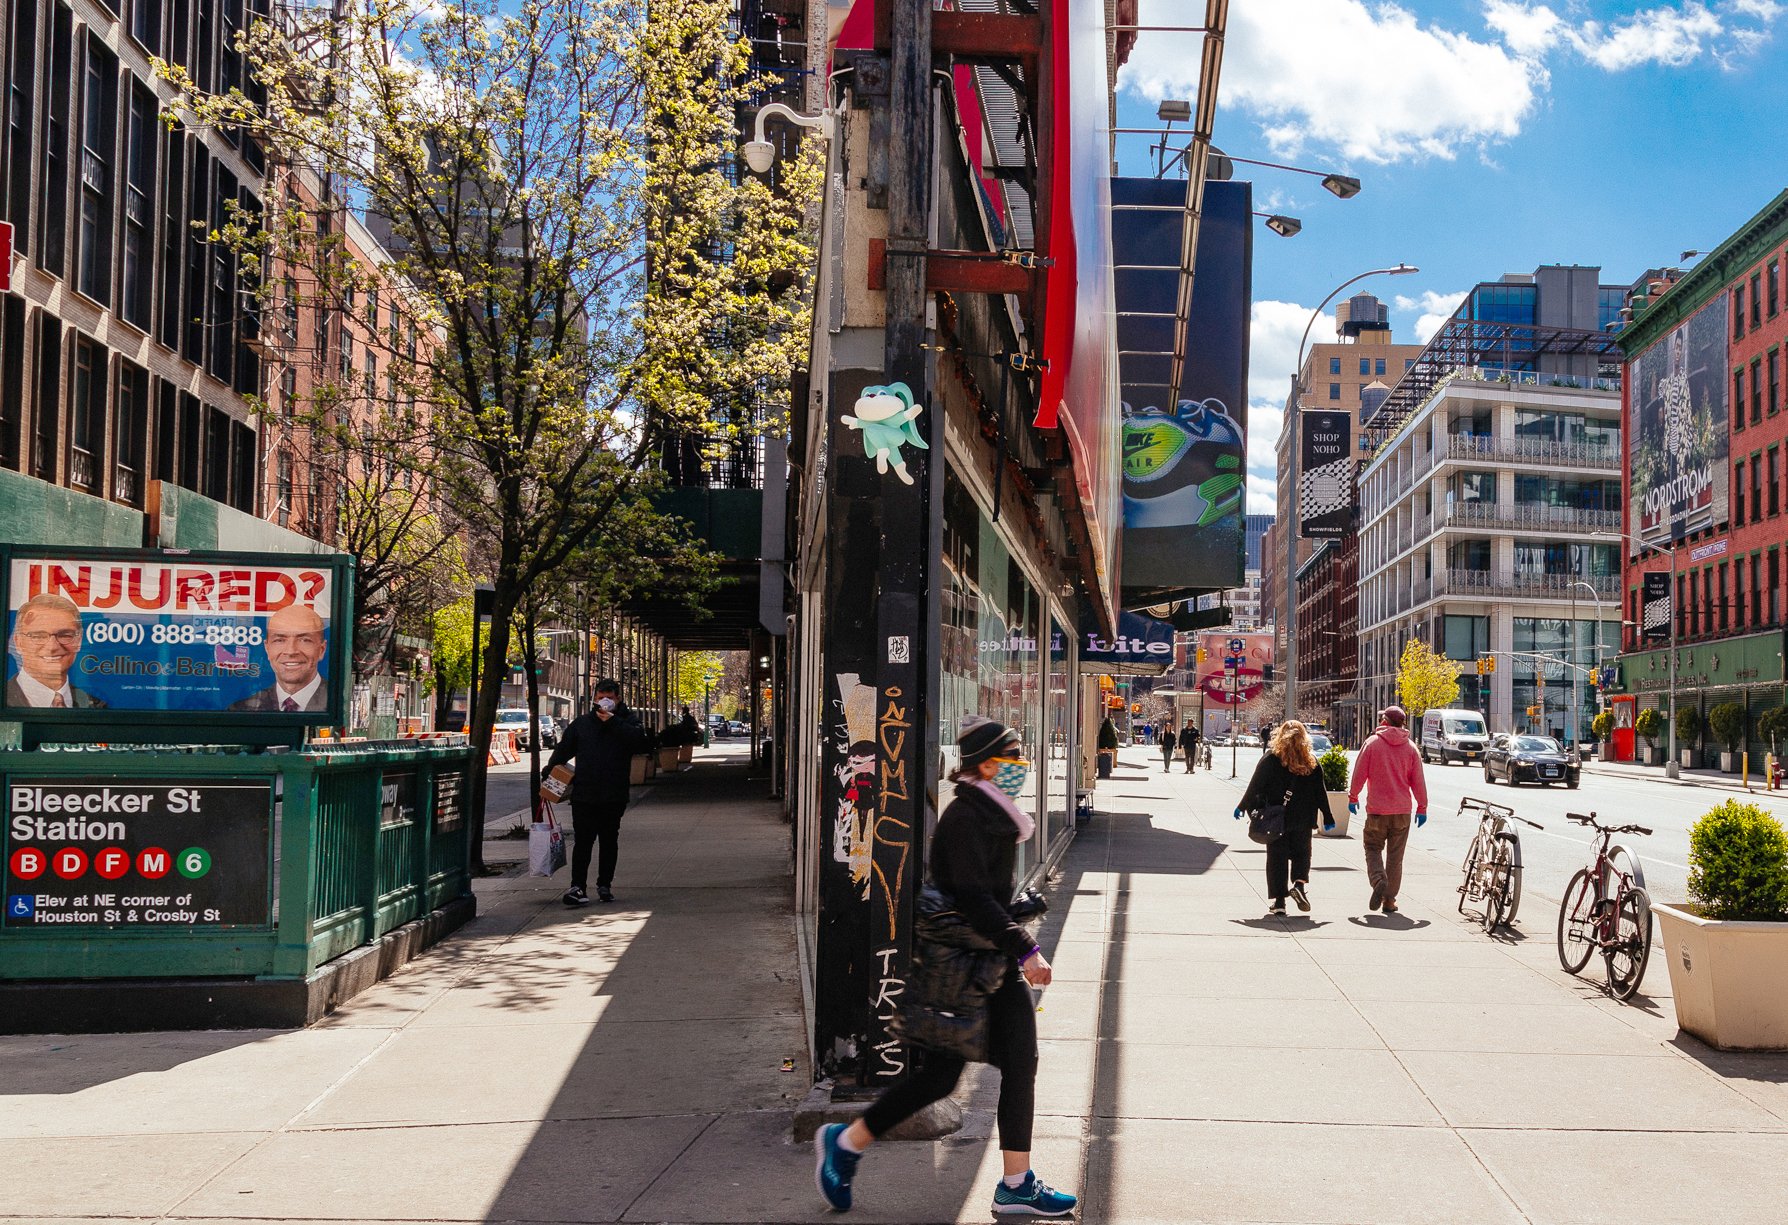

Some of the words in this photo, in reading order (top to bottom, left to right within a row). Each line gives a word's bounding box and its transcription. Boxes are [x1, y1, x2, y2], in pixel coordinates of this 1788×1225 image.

[1313, 433, 1340, 442] SHOP
[1312, 445, 1340, 454] NOHO
[1127, 457, 1153, 468] AIR
[1645, 467, 1707, 517] NORDSTROM
[28, 564, 327, 613] INJURED?
[86, 622, 145, 645] (800)
[151, 623, 263, 646] 888-8888
[80, 655, 161, 676] Cellino
[175, 657, 261, 677] Barnes
[11, 788, 154, 812] Bleecker
[166, 789, 201, 813] St
[11, 815, 126, 841] Station
[20, 855, 38, 872] B
[62, 855, 81, 872] D
[105, 854, 120, 872] F
[143, 854, 165, 872] M
[186, 853, 202, 872] 6
[35, 895, 67, 907] Elev
[73, 896, 88, 907] at
[94, 894, 116, 906] NE
[120, 896, 170, 907] corner
[175, 893, 192, 906] of
[34, 911, 98, 923] Houston
[104, 910, 121, 923] St
[127, 911, 138, 922] &
[144, 909, 198, 924] Crosby
[203, 909, 220, 922] St
